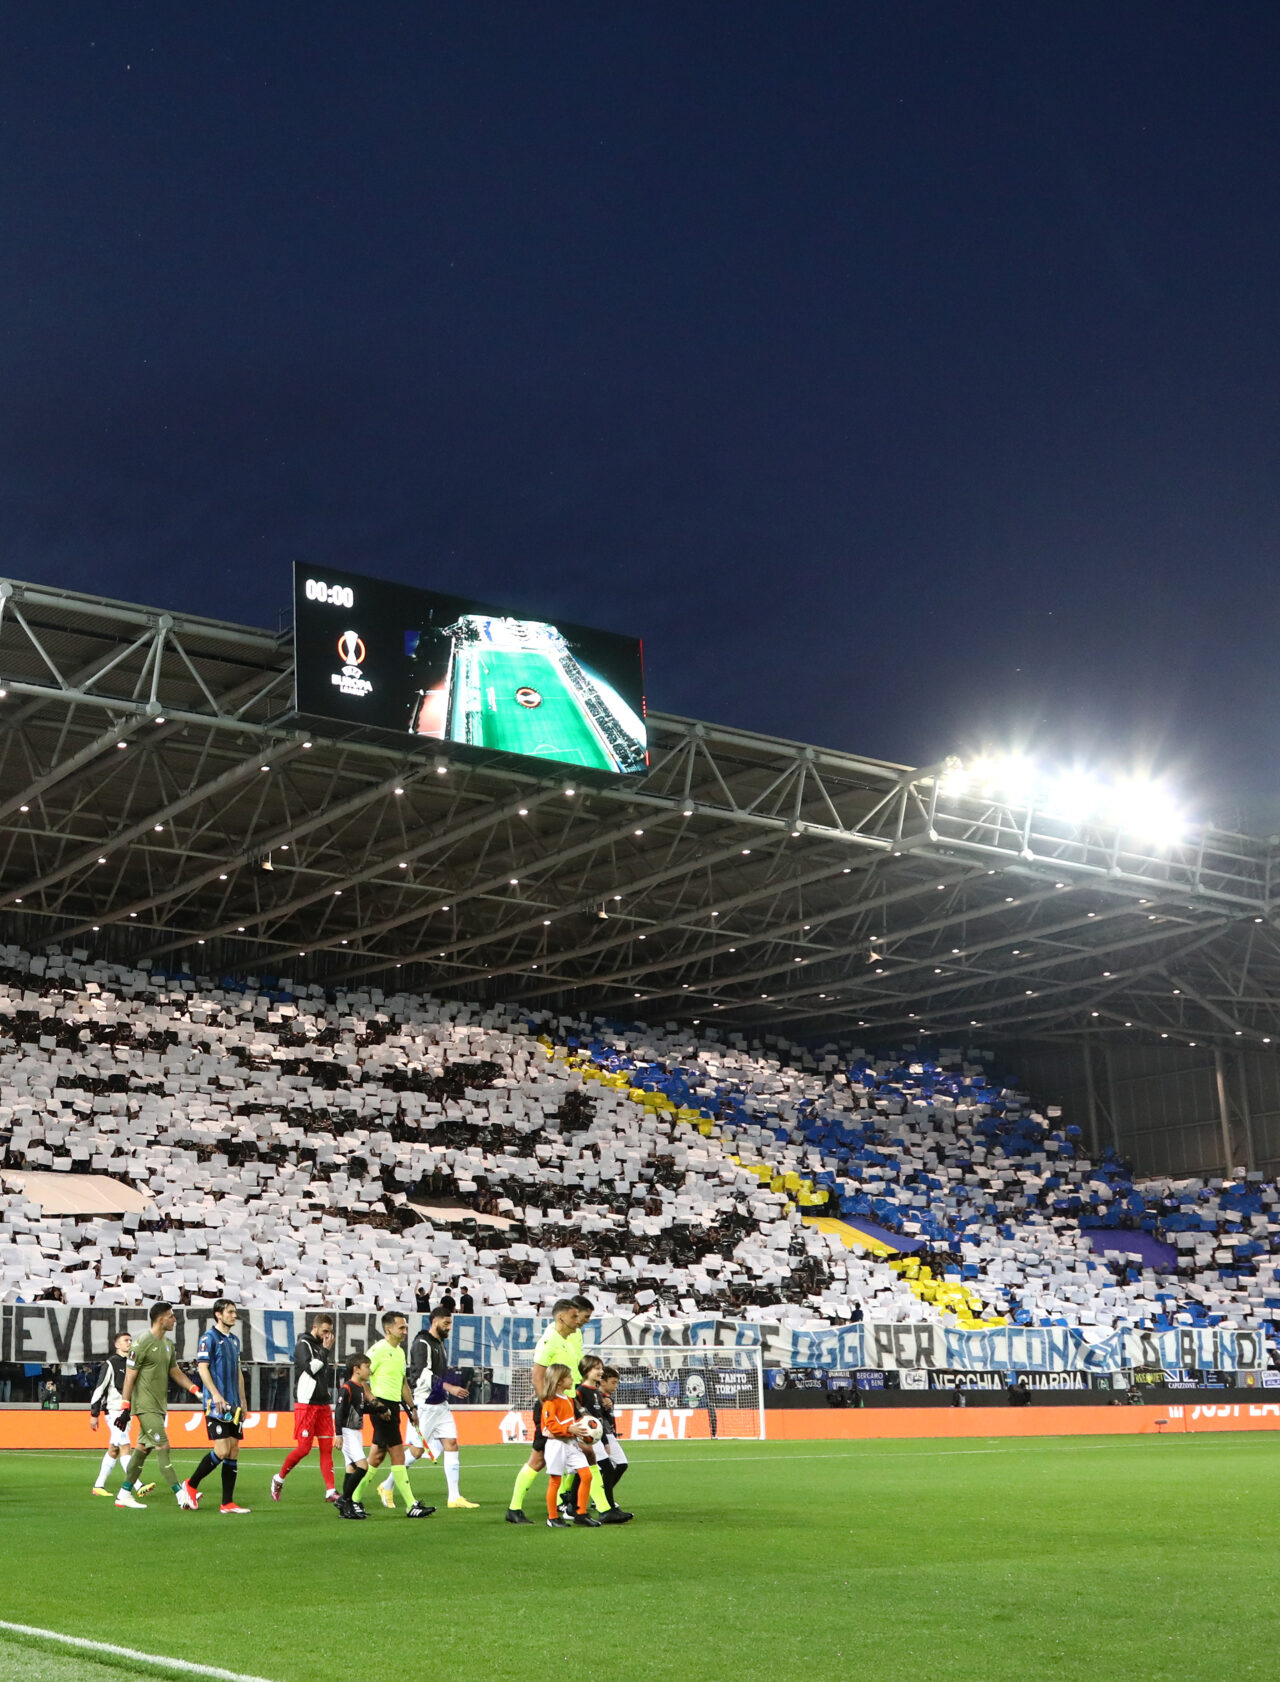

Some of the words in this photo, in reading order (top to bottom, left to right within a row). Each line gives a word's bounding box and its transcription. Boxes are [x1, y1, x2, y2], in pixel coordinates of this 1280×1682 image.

[306, 579, 353, 608] 00:00
[874, 1325, 936, 1368] PER
[719, 1373, 747, 1383] TANTO
[932, 1373, 1002, 1390] VECCHIA
[1018, 1372, 1083, 1390] GUARDIA
[631, 1409, 693, 1440] EAT
